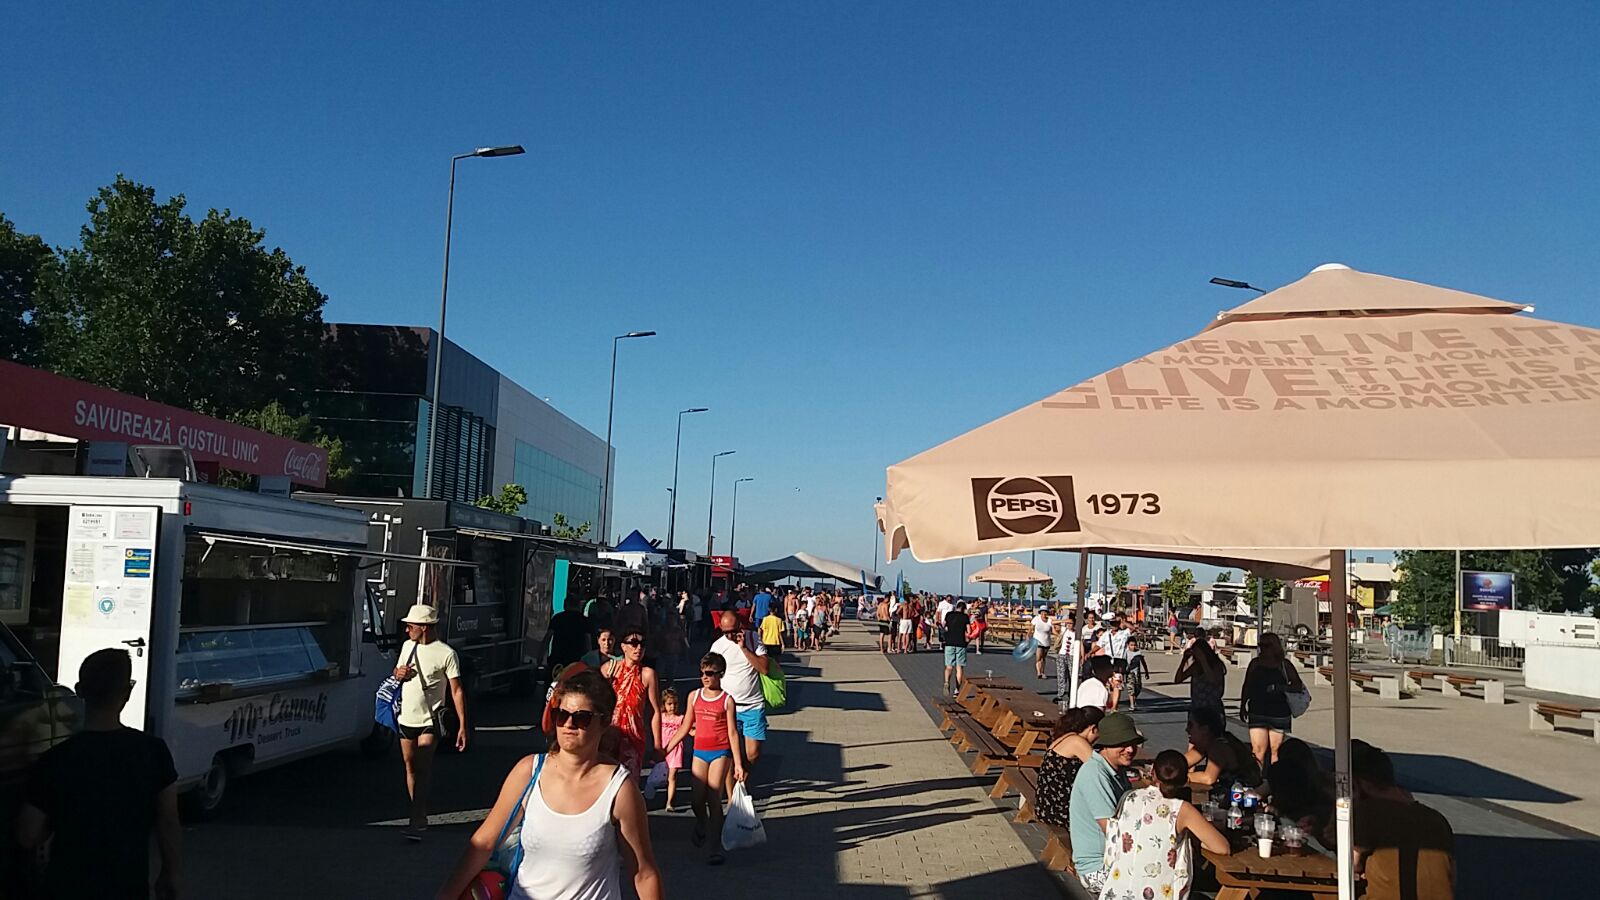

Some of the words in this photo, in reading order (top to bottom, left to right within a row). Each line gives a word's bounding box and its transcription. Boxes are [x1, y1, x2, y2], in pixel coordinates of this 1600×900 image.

[1300, 328, 1478, 356] LIVE
[1489, 325, 1564, 346] IT
[1340, 356, 1374, 366] IS
[1383, 355, 1407, 365] A
[1105, 367, 1332, 397] LIVE
[1327, 367, 1379, 384] IT
[1386, 363, 1498, 381] LIFE
[1505, 359, 1560, 375] IS
[1400, 372, 1600, 395] MOMEN
[1111, 396, 1205, 410] LIFE
[1217, 397, 1261, 410] IS
[1273, 398, 1306, 410] A
[74, 399, 172, 445] SAVUREAZĂ
[178, 426, 229, 458] GUSTUL
[232, 439, 260, 464] UNIC
[991, 498, 1059, 514] PEPSI
[1086, 492, 1161, 515] 1973
[224, 702, 267, 744] Mr.
[268, 692, 328, 724] Cannoli
[257, 730, 282, 745] Dessert
[285, 727, 301, 737] Truck
